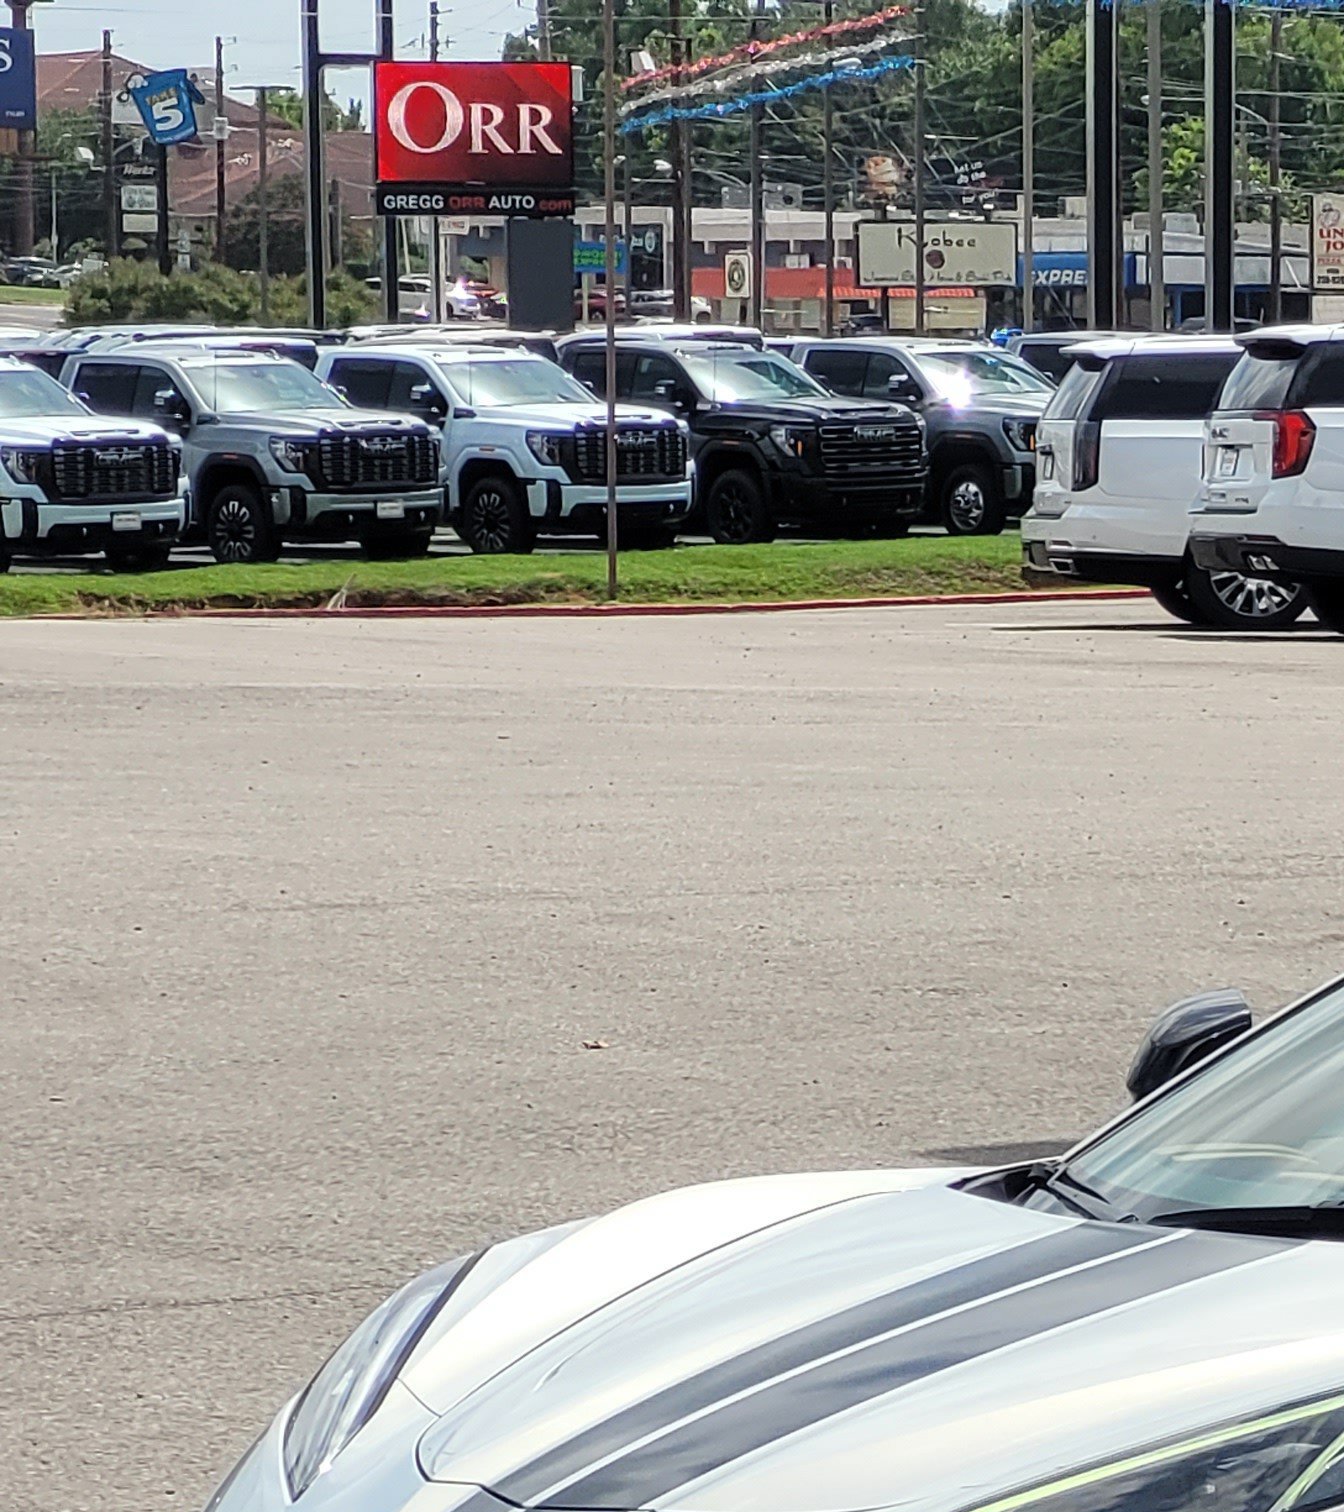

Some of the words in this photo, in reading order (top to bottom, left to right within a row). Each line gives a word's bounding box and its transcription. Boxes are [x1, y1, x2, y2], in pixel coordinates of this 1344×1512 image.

[152, 97, 184, 131] 5
[383, 195, 444, 210] GREGG
[449, 195, 486, 210] ORR
[488, 195, 535, 210] AUTO
